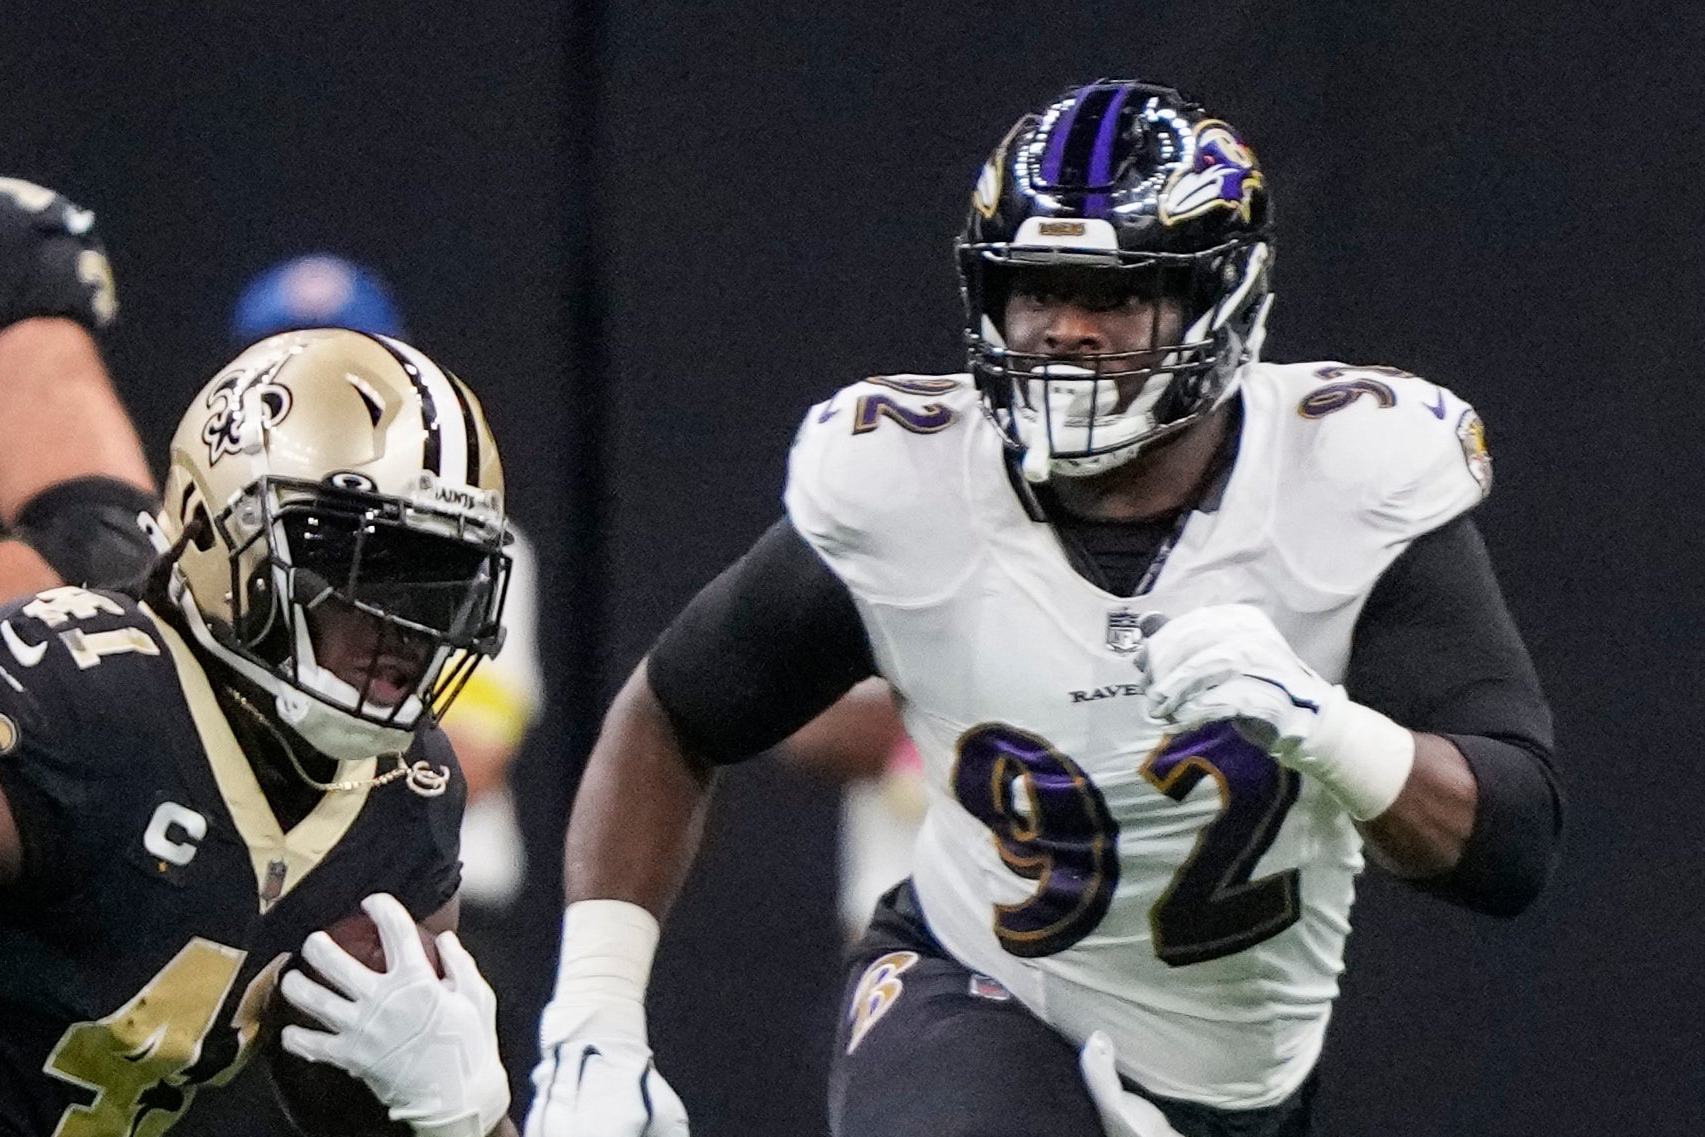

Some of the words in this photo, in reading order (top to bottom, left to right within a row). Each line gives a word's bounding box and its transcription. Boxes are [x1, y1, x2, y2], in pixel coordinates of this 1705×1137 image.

[434, 487, 476, 510] AINTS
[1068, 683, 1145, 703] RAVE
[143, 801, 208, 866] C
[952, 722, 1301, 967] 92
